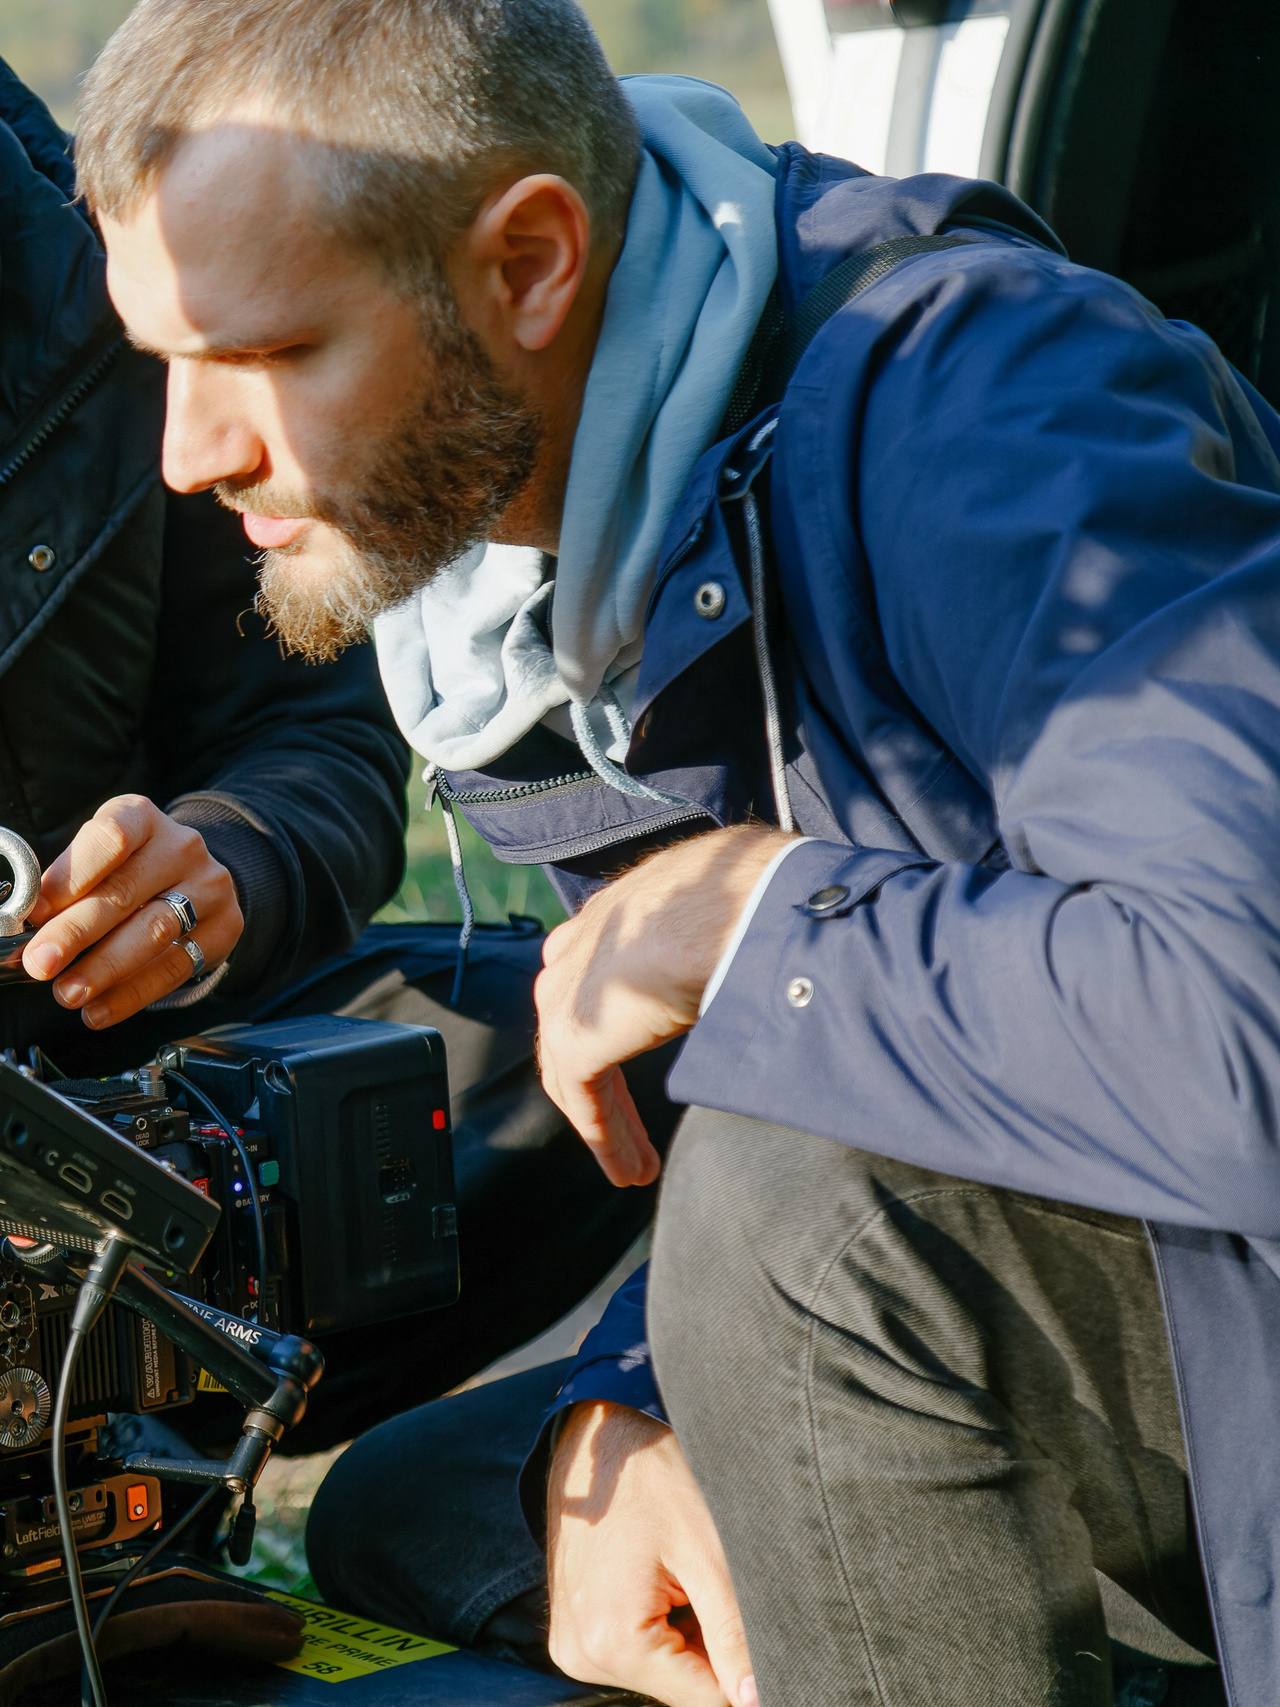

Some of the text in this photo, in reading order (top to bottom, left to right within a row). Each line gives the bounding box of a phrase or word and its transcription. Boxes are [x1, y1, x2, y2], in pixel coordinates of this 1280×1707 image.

[136, 1132, 150, 1140] DEAD
[214, 1317, 262, 1345] ARMS
[326, 1643, 398, 1667] PRIME
[302, 1661, 343, 1675] 58
